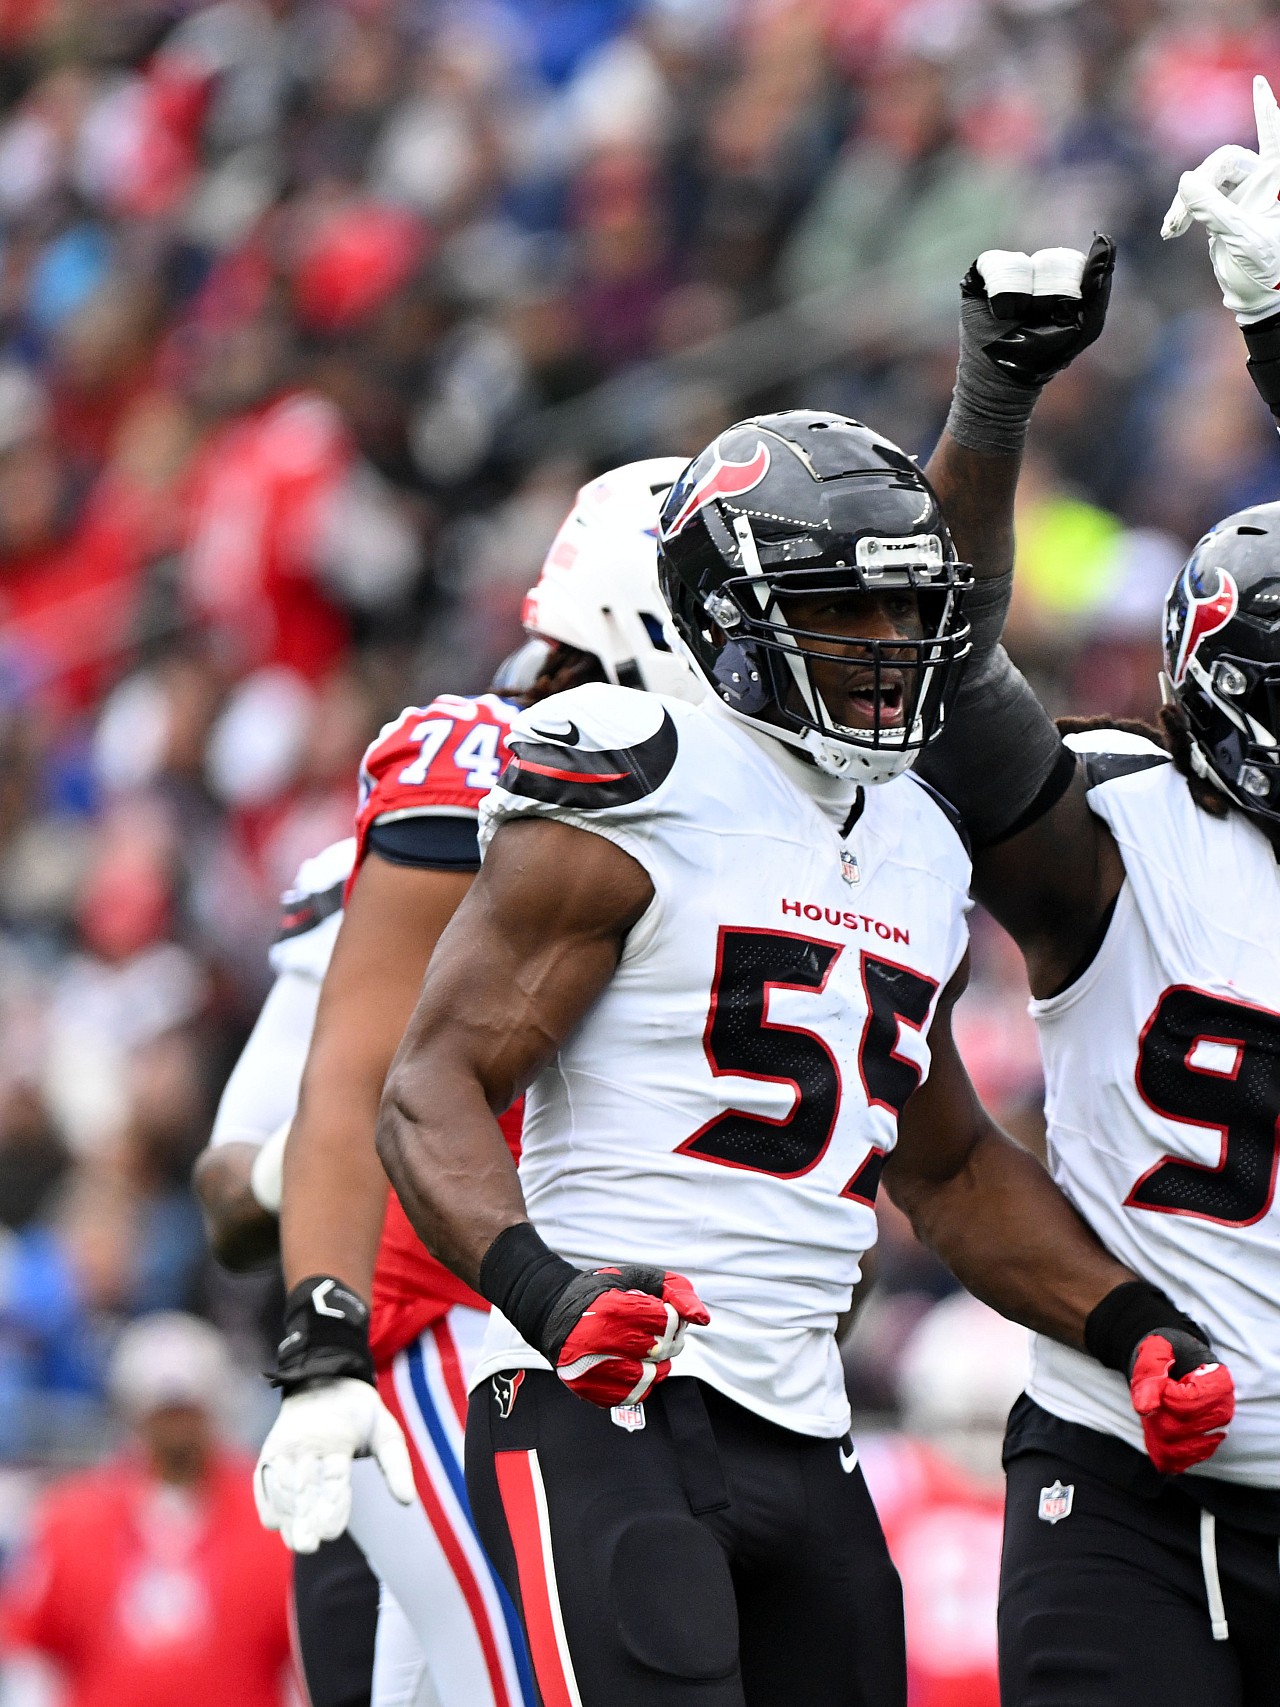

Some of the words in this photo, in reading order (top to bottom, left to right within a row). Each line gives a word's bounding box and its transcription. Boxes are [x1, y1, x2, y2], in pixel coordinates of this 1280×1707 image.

[397, 718, 502, 790] 74
[781, 898, 911, 946] HOUSTON
[673, 924, 940, 1211] 55
[617, 1410, 642, 1425] NFL
